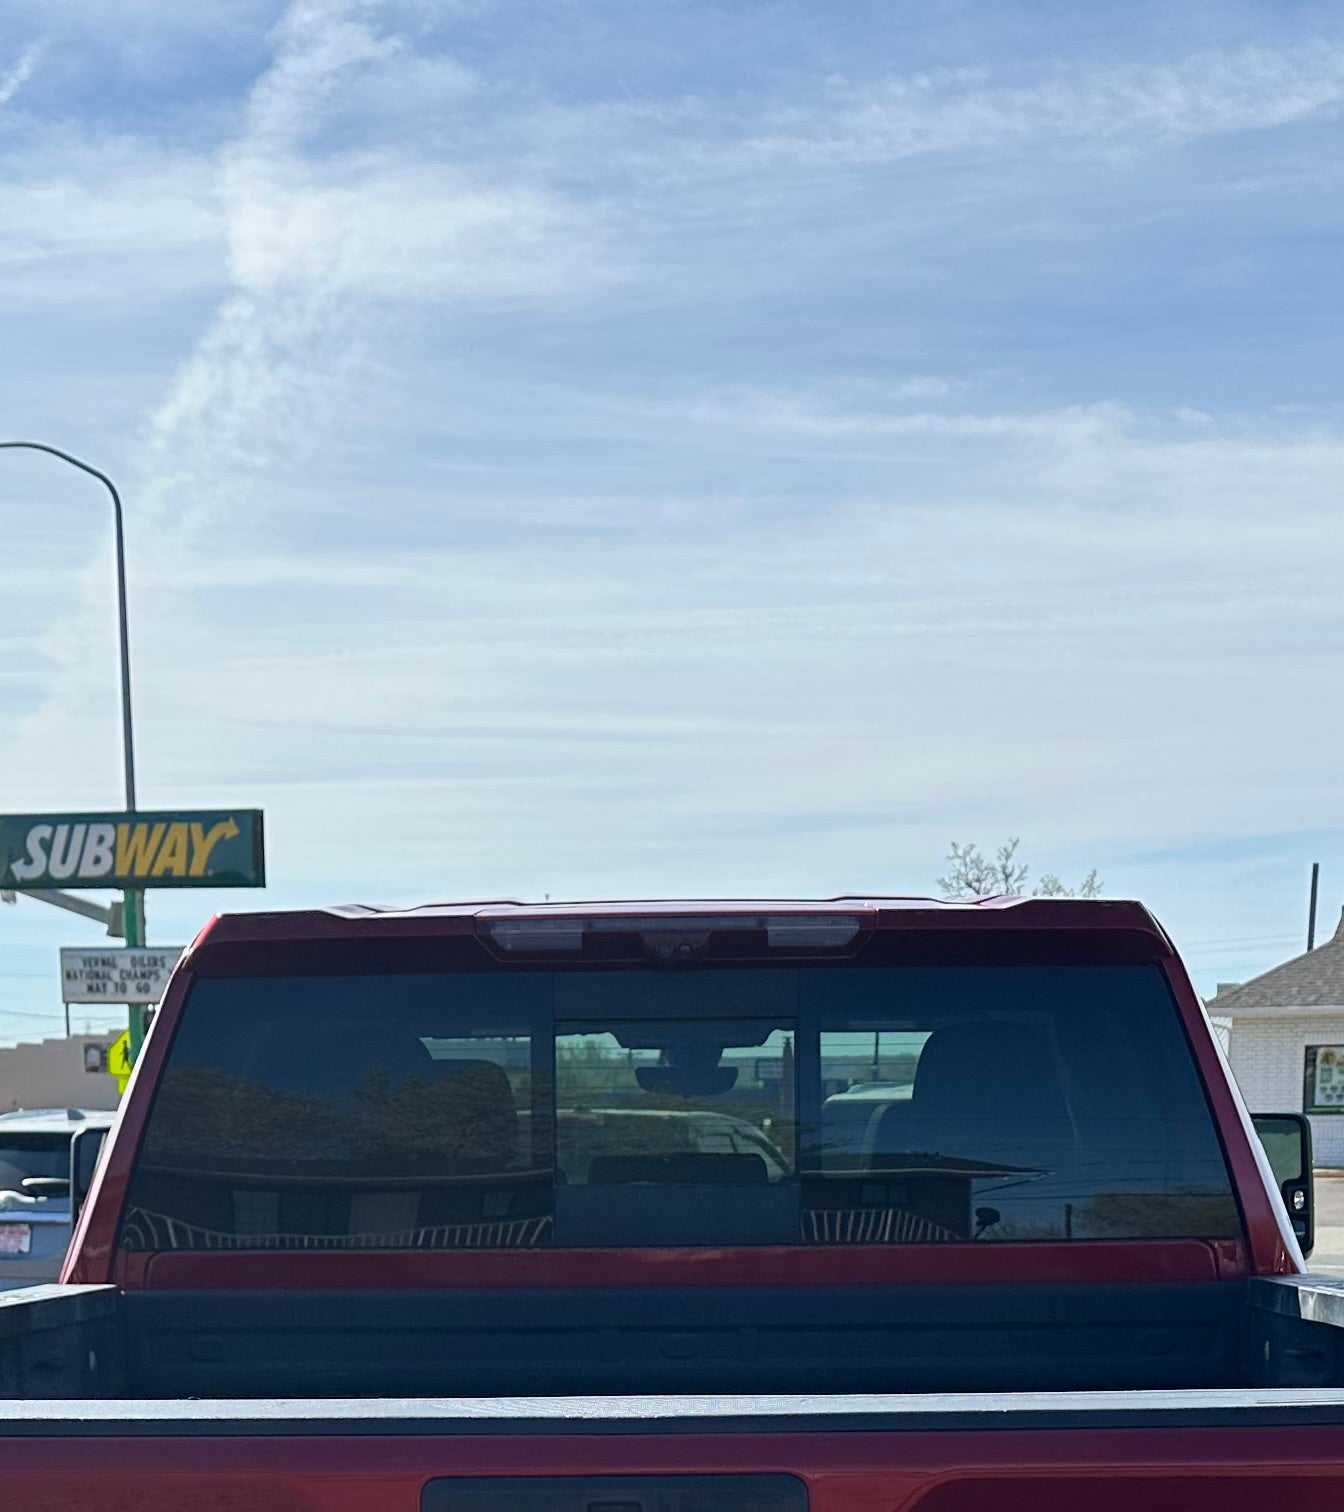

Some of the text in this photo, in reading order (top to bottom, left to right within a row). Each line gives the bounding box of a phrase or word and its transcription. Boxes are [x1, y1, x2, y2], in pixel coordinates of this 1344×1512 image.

[10, 816, 240, 881] SUBWAY
[65, 969, 161, 981] NATIONAL CHAMPS
